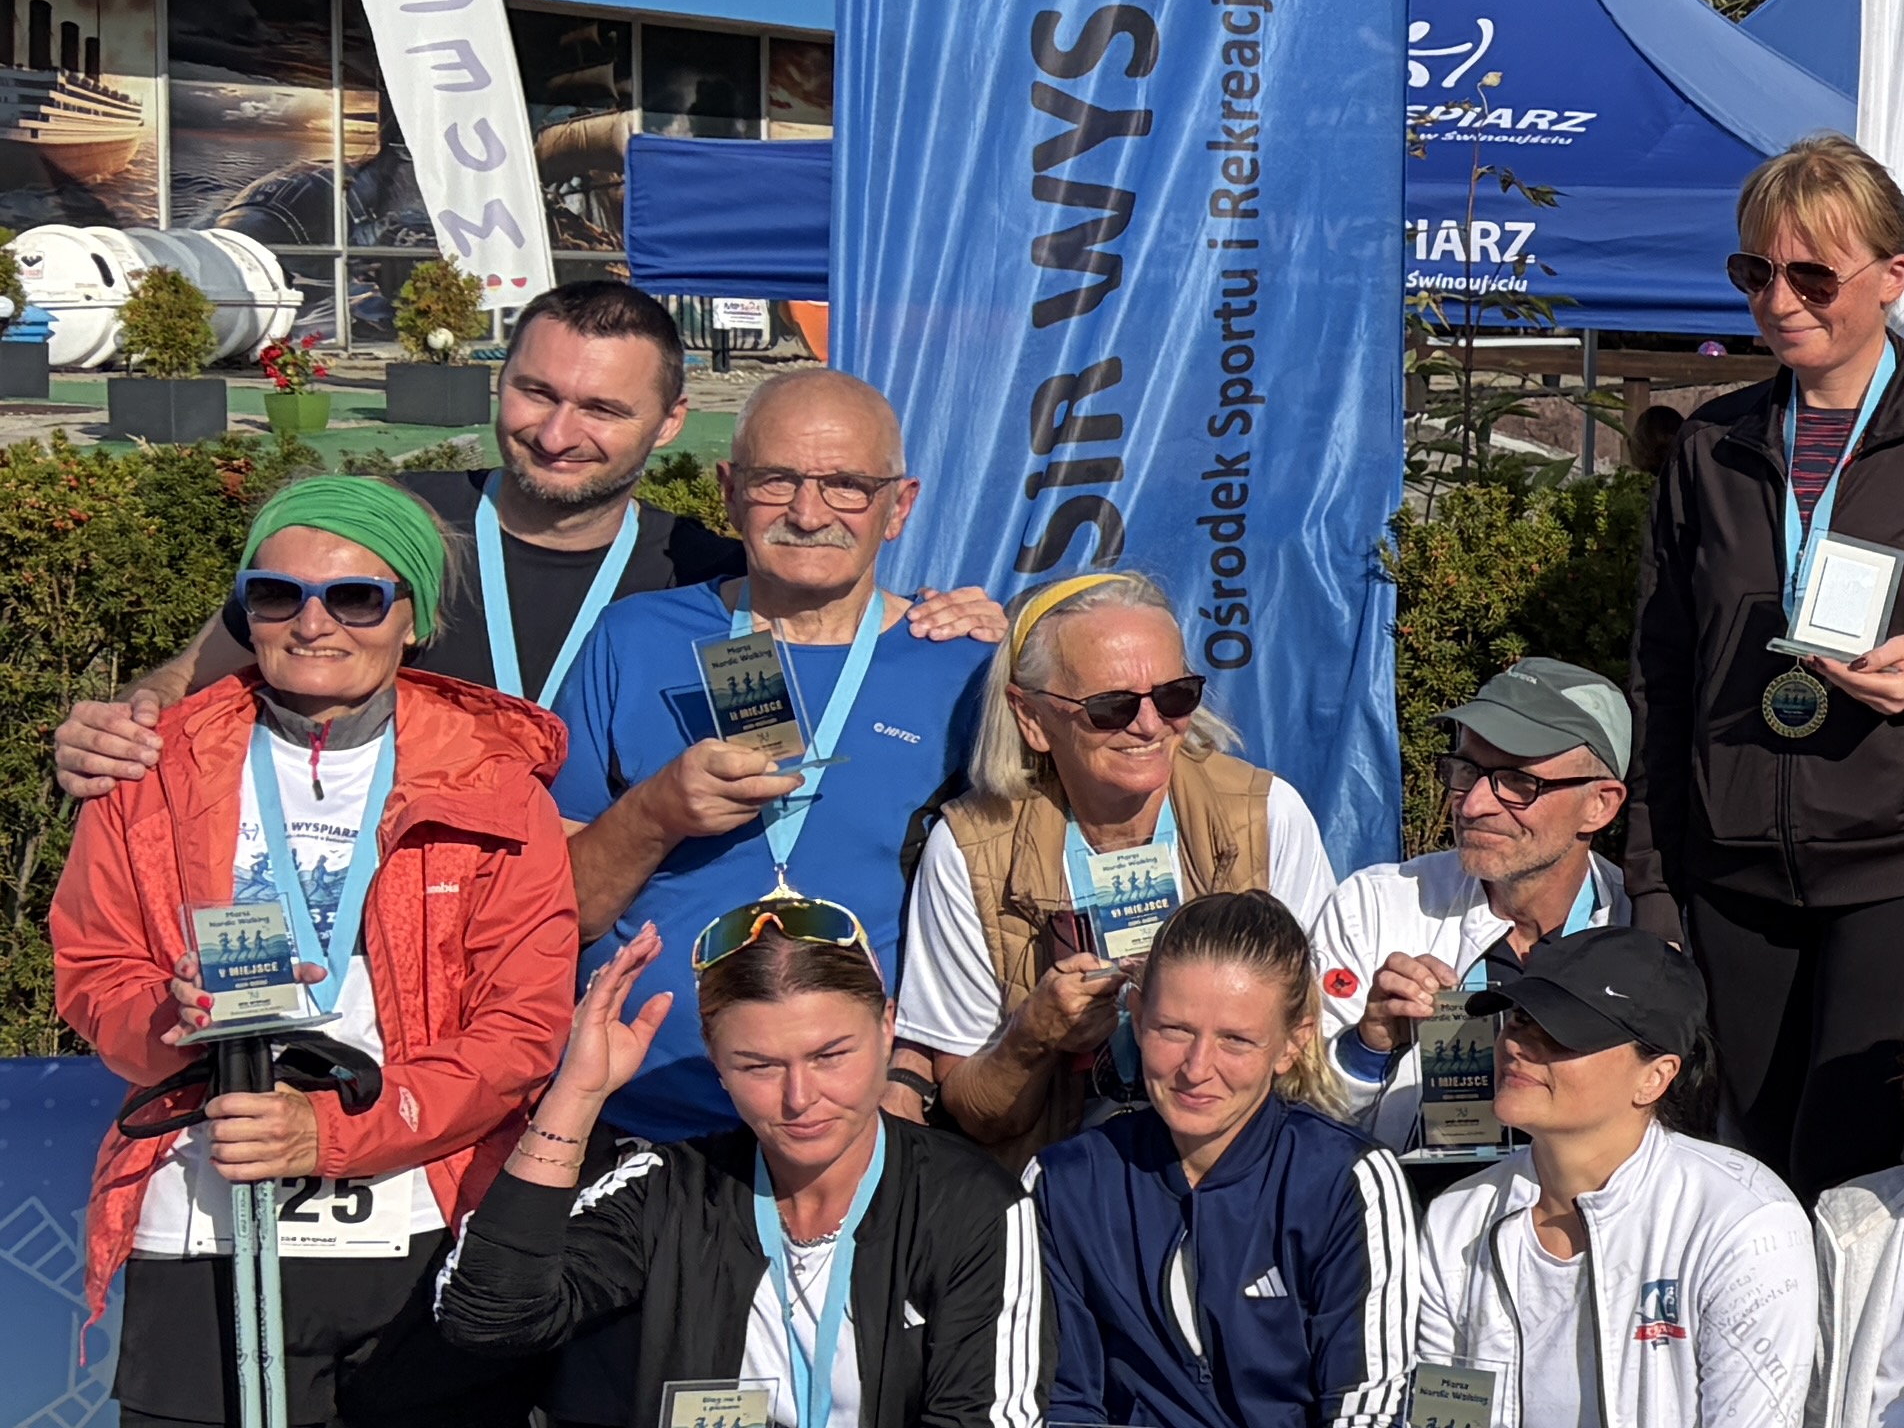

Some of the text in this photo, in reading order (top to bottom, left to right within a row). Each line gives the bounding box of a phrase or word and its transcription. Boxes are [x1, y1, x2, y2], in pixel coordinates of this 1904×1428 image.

[1208, 235, 1260, 250] i
[1408, 216, 1537, 264] IARZ
[1207, 265, 1267, 438] Sportu
[1199, 452, 1253, 671] Ośrodek
[738, 699, 784, 718] MIEJSCE
[884, 726, 921, 744] HI-TEC
[1123, 898, 1170, 915] MIEJSCE
[229, 961, 279, 978] MIEJSCE
[1438, 1075, 1489, 1088] MIEJSCE
